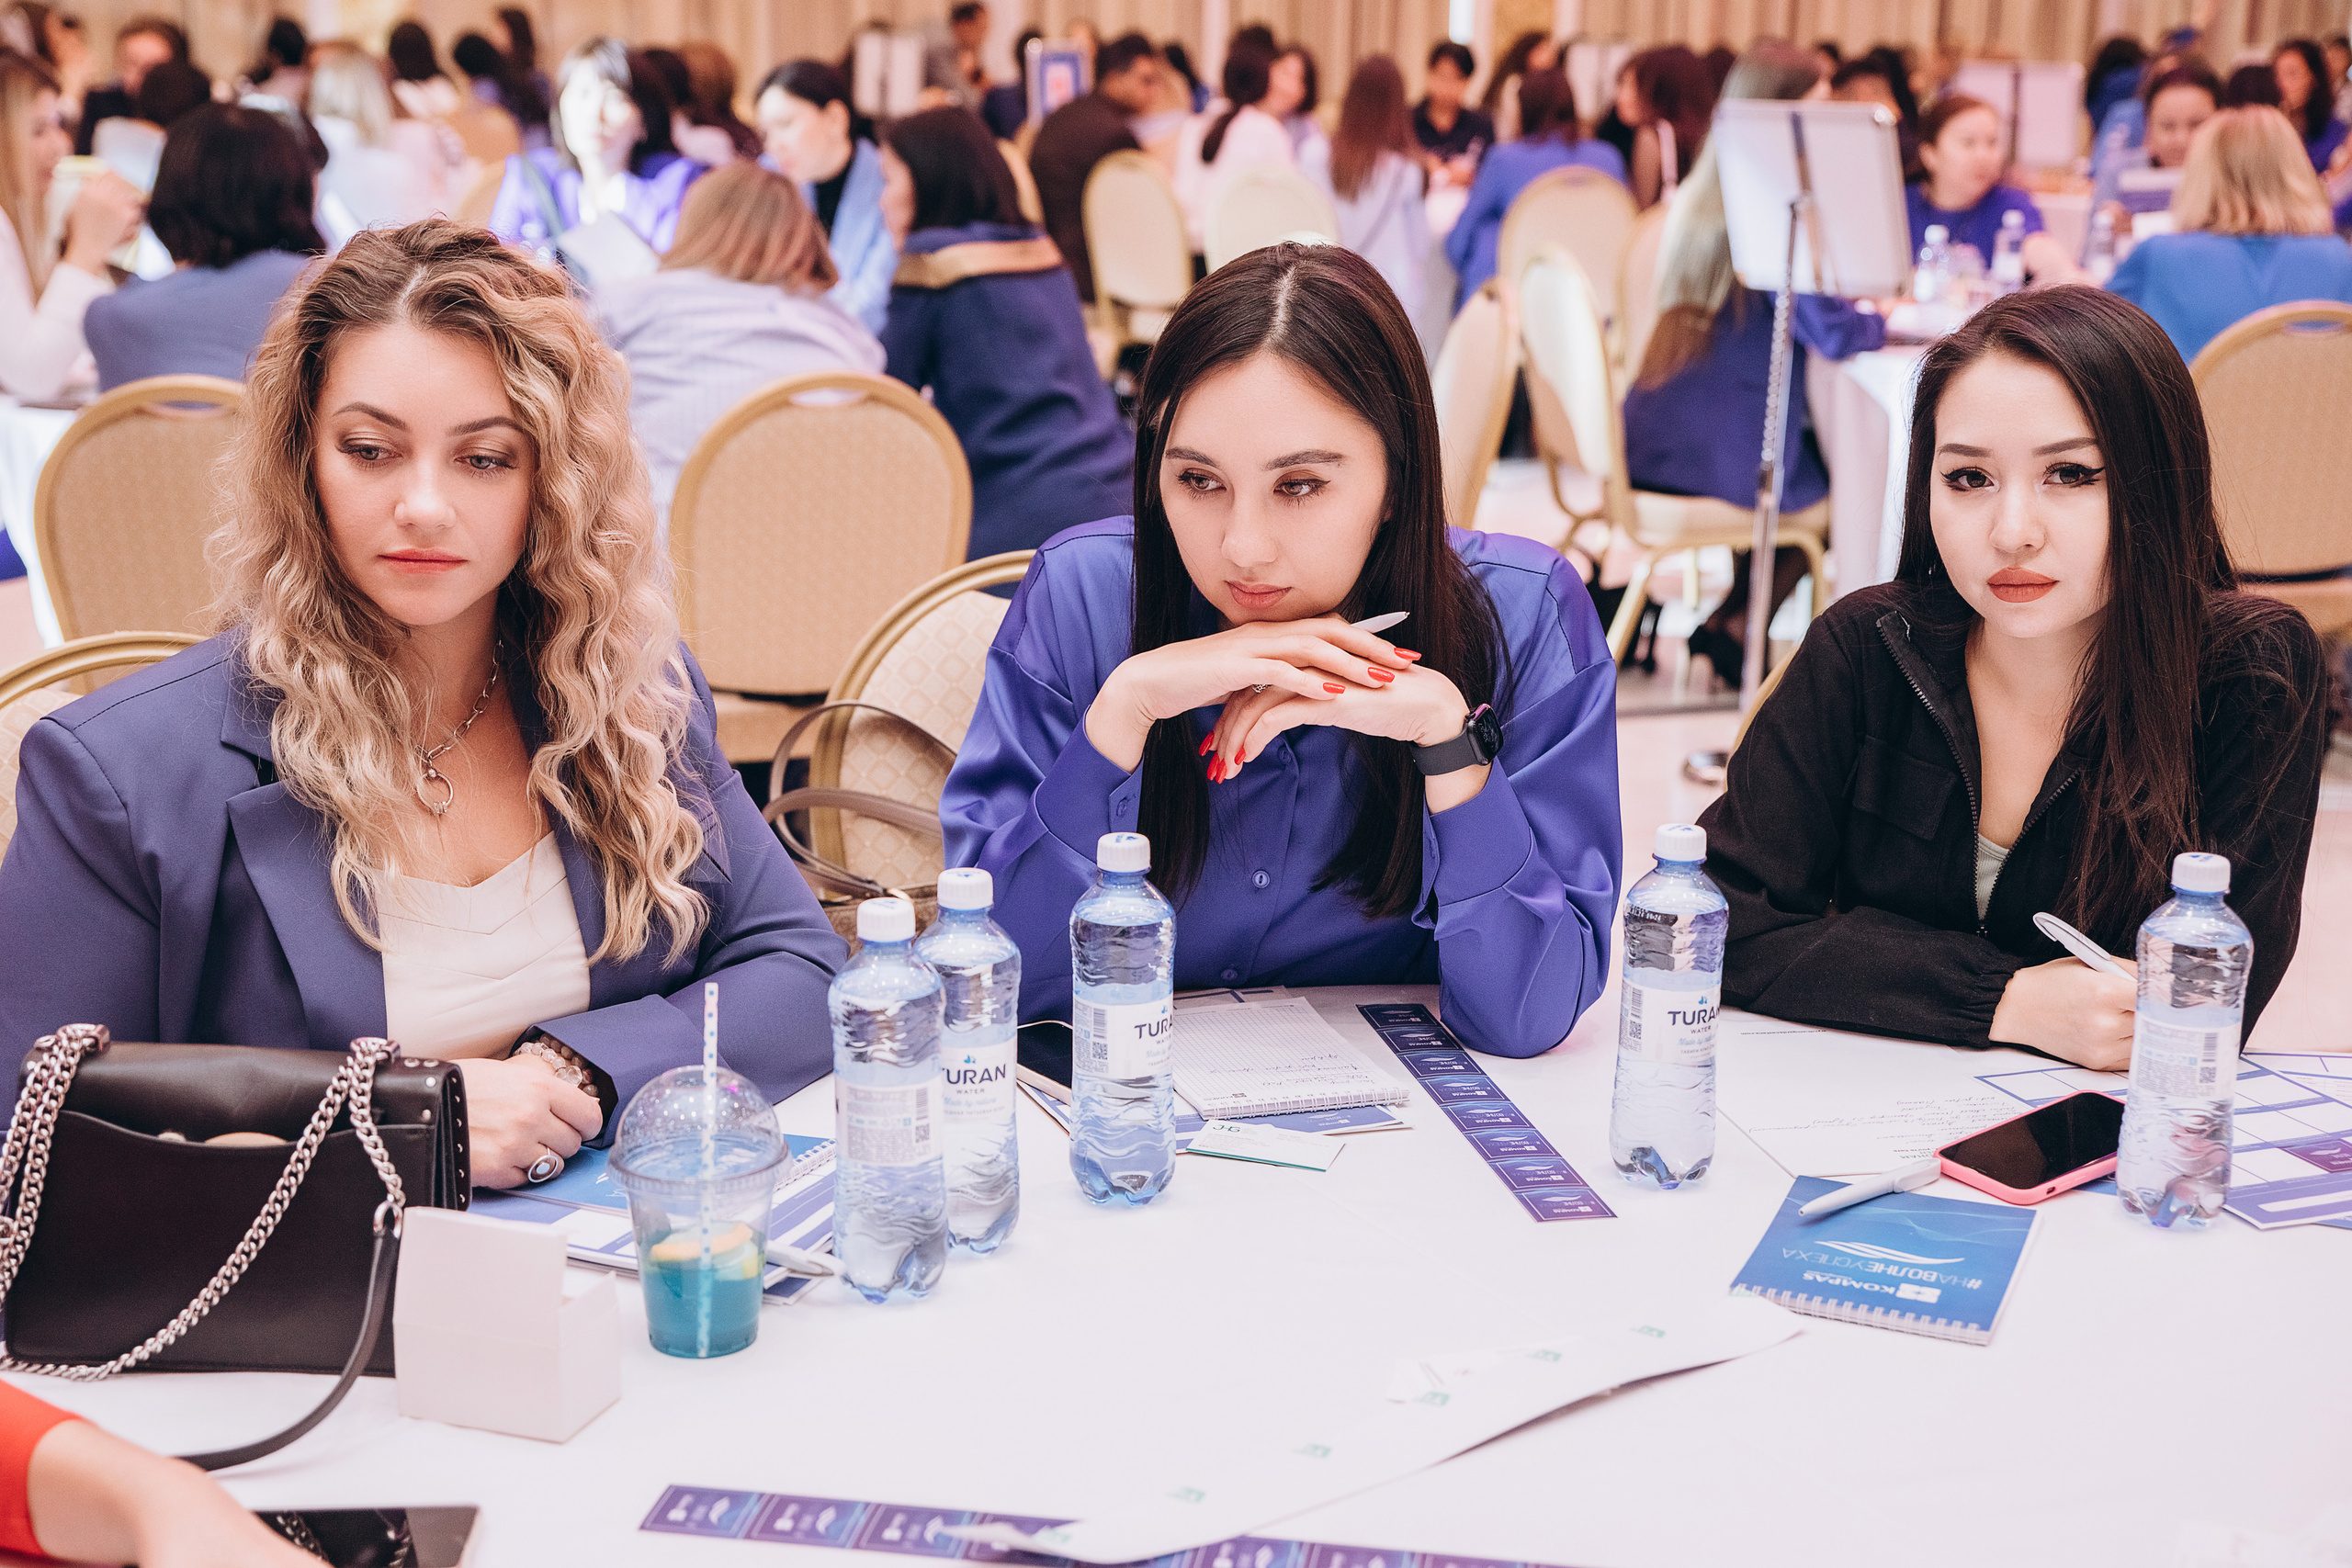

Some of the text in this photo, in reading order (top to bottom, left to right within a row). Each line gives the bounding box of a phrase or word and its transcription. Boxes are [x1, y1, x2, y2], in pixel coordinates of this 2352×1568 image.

[1690, 1025, 1712, 1034] WATER
[942, 1063, 1006, 1085] URAN
[1781, 1247, 1983, 1290] #НАВОЛНЕУСПЕХА
[1803, 1272, 1896, 1294] KOMPAS
